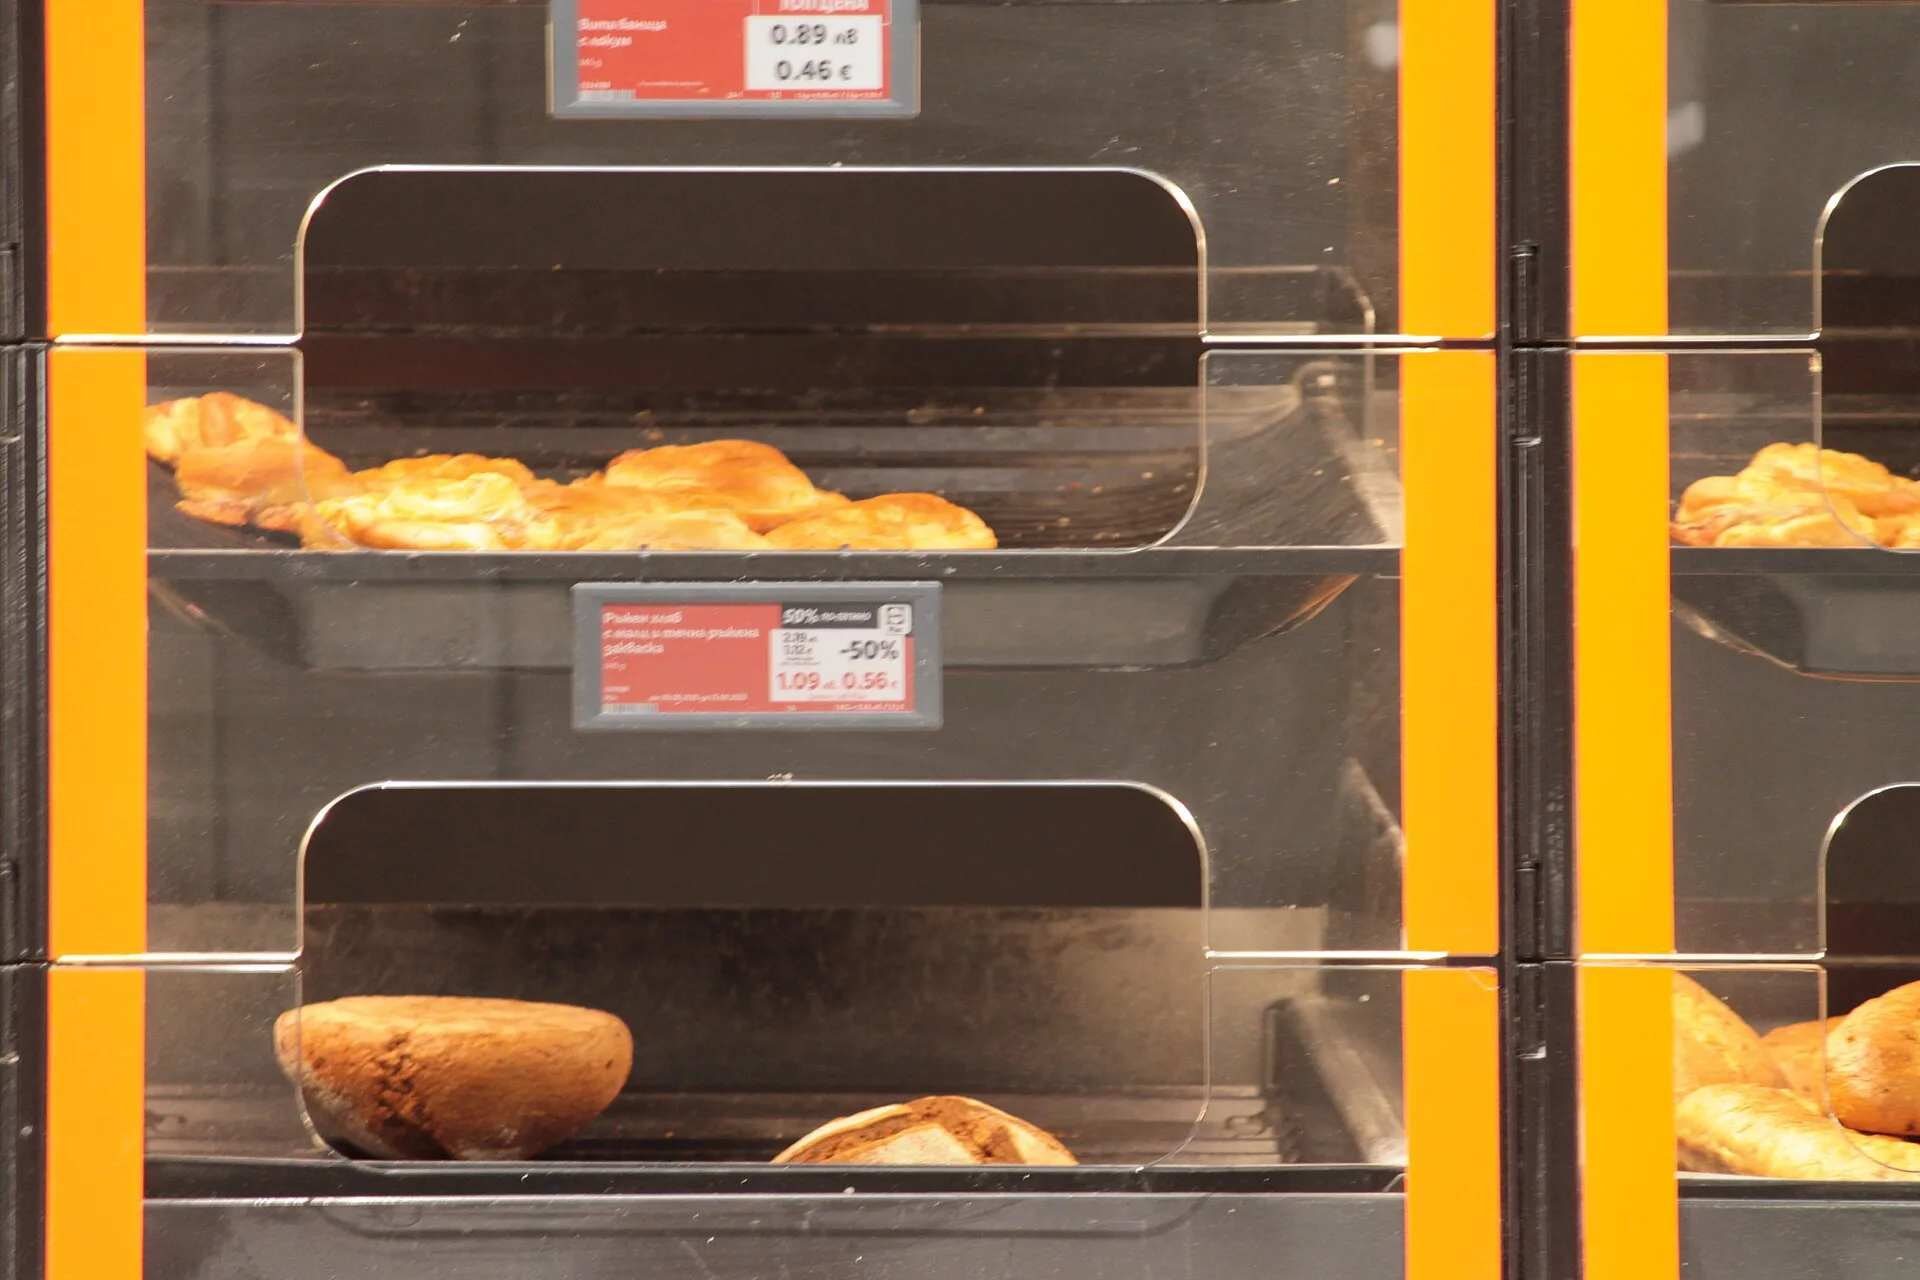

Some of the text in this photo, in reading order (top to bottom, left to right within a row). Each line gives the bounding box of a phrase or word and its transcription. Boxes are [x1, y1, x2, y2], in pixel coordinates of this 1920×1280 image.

[771, 24, 827, 45] 0.89
[775, 60, 853, 80] 0.46 €
[782, 608, 819, 625] 50%
[840, 640, 899, 659] -50%
[776, 671, 820, 690] 1.09
[842, 671, 887, 690] 0.56
